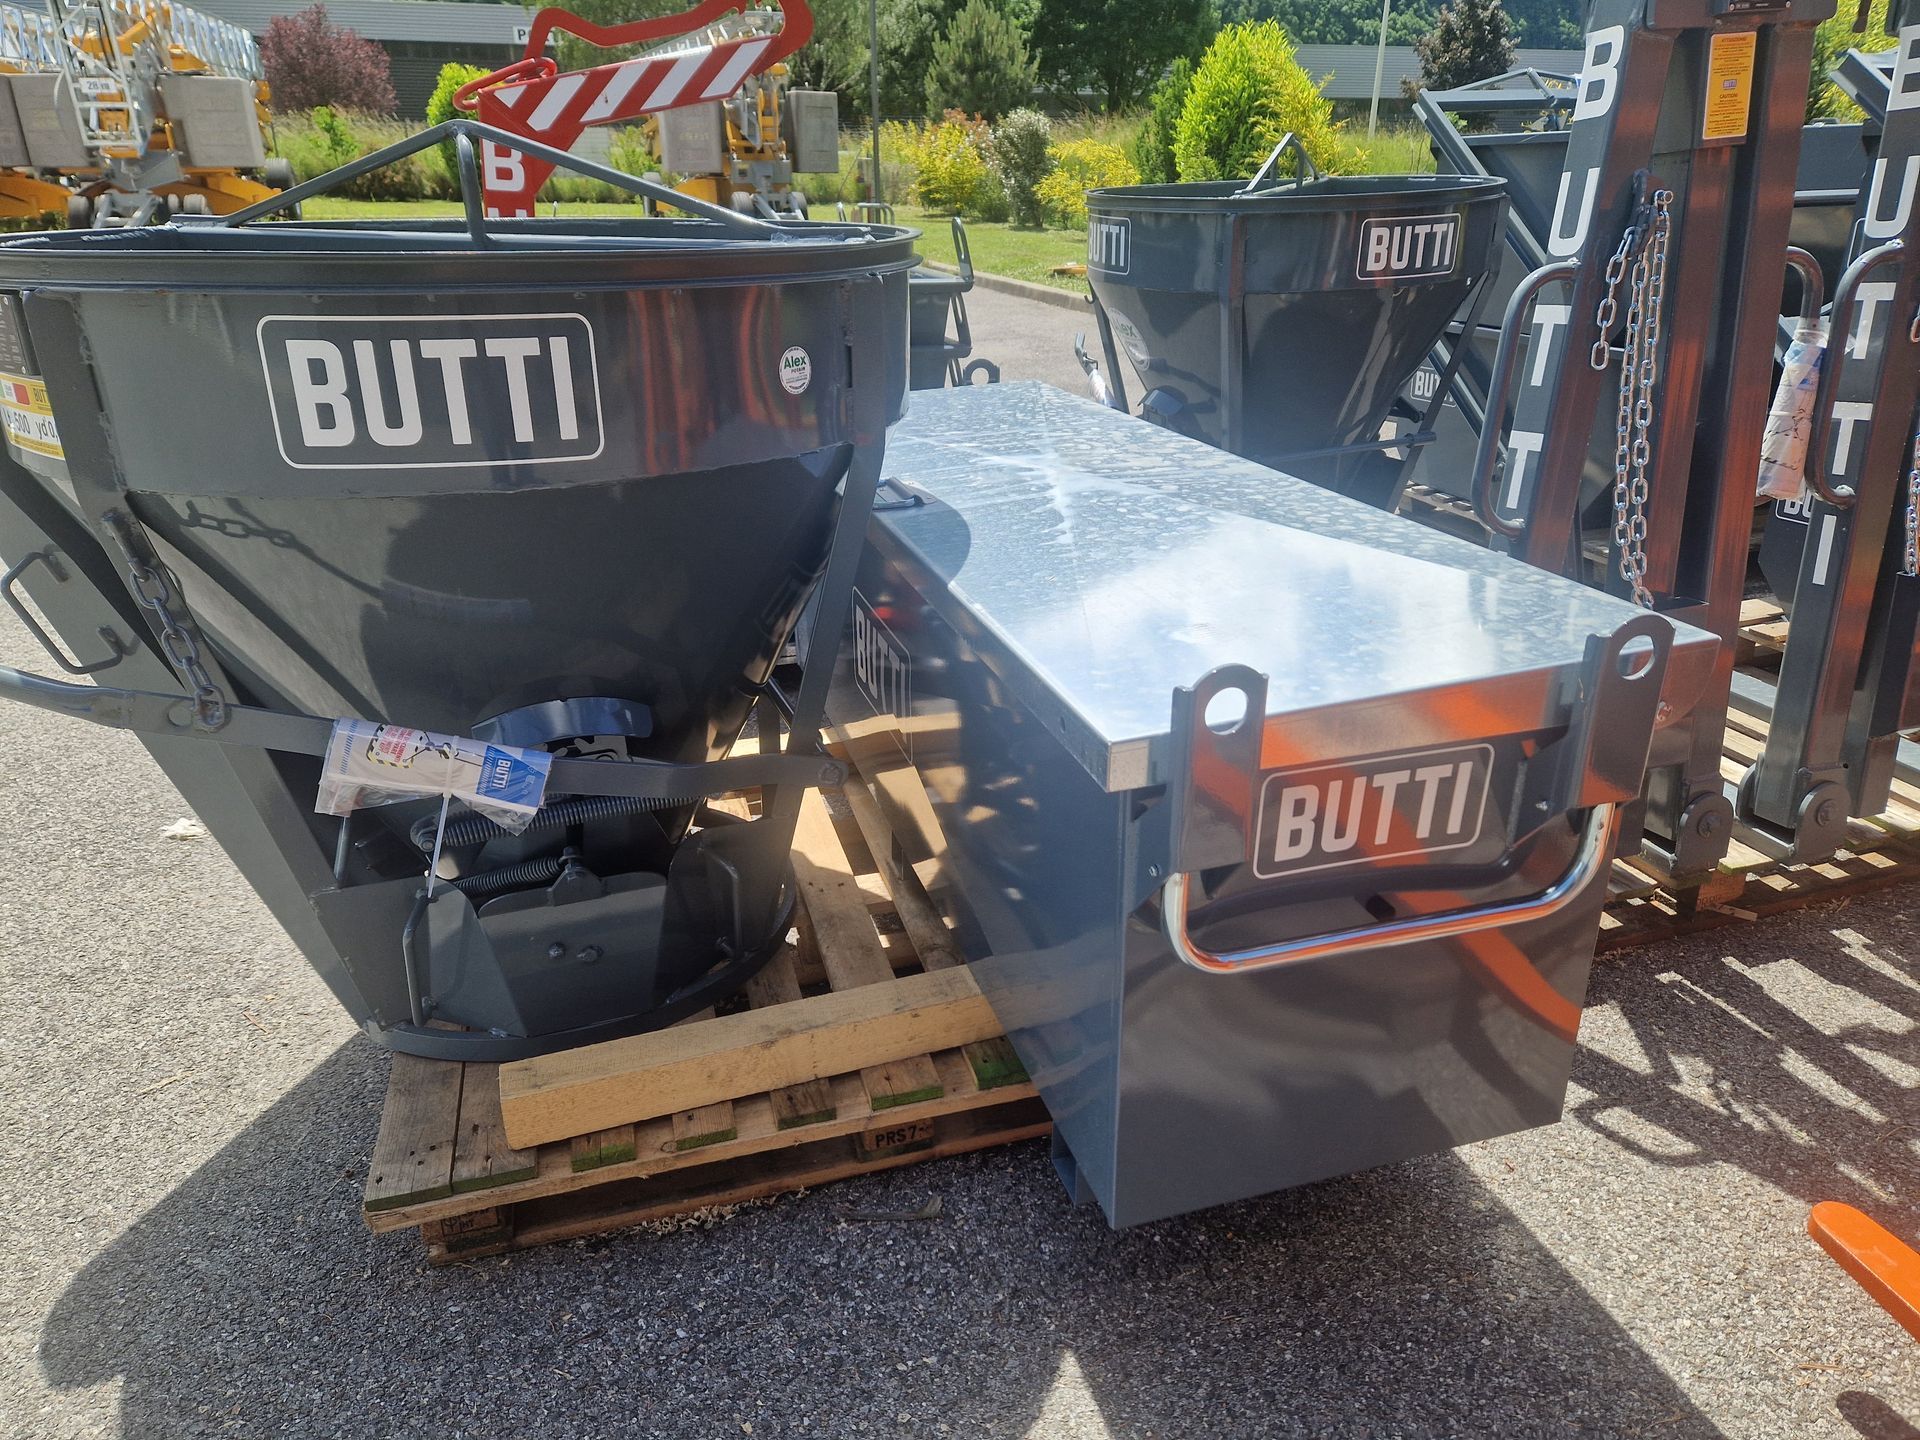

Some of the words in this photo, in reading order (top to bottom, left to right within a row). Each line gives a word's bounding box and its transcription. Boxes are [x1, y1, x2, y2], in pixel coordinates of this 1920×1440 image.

[1366, 223, 1455, 271] BUTTI
[783, 355, 807, 370] Alex
[285, 336, 579, 446] BUTTI
[13, 411, 31, 435] 500
[856, 604, 908, 744] BUTTI
[492, 759, 512, 789] BUTTI
[1274, 761, 1474, 863] BUTTI
